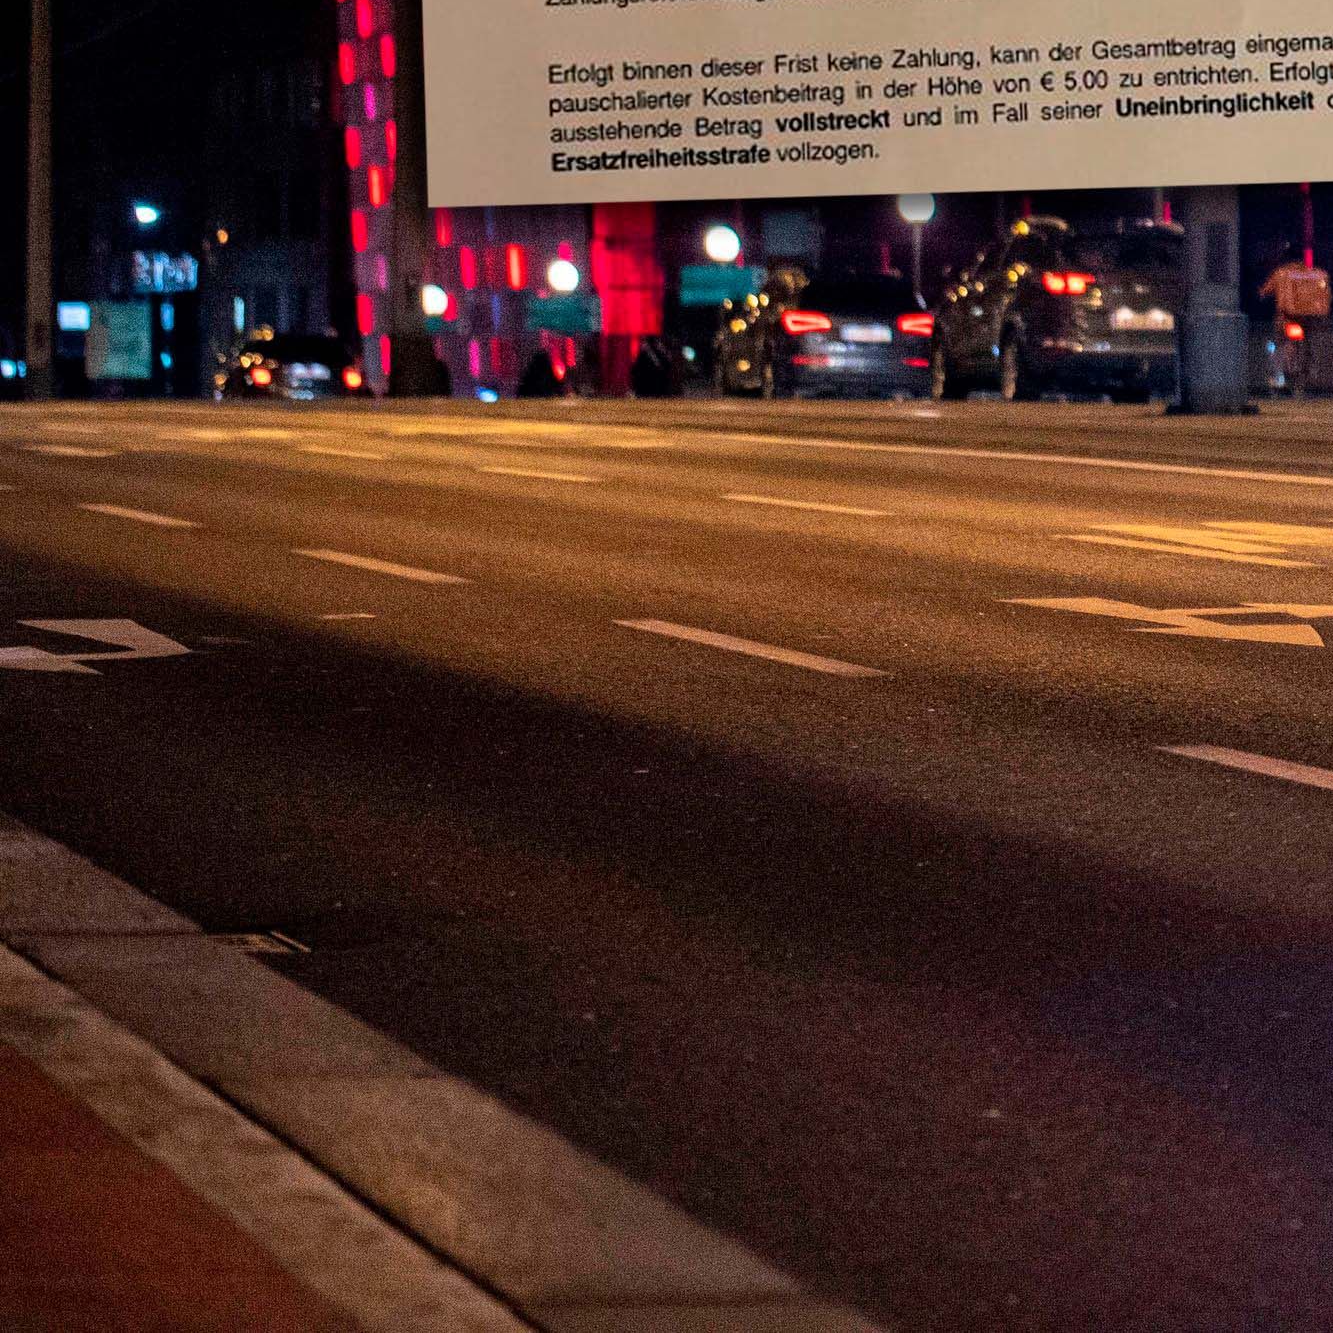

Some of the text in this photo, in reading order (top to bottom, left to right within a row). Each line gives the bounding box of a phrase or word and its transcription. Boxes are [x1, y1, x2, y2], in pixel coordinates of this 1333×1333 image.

[548, 63, 614, 87] Erfolgt
[622, 61, 693, 81] binnen
[700, 58, 764, 78] dieser
[773, 54, 819, 74] Frist
[827, 51, 883, 72] keine
[891, 47, 981, 71] Zahlung,
[989, 45, 1040, 65] kann
[1048, 42, 1082, 62] der
[1091, 37, 1235, 60] Gesamtbetrag
[551, 141, 879, 172] Ersatzfreiheitsstrafe vollzogen.
